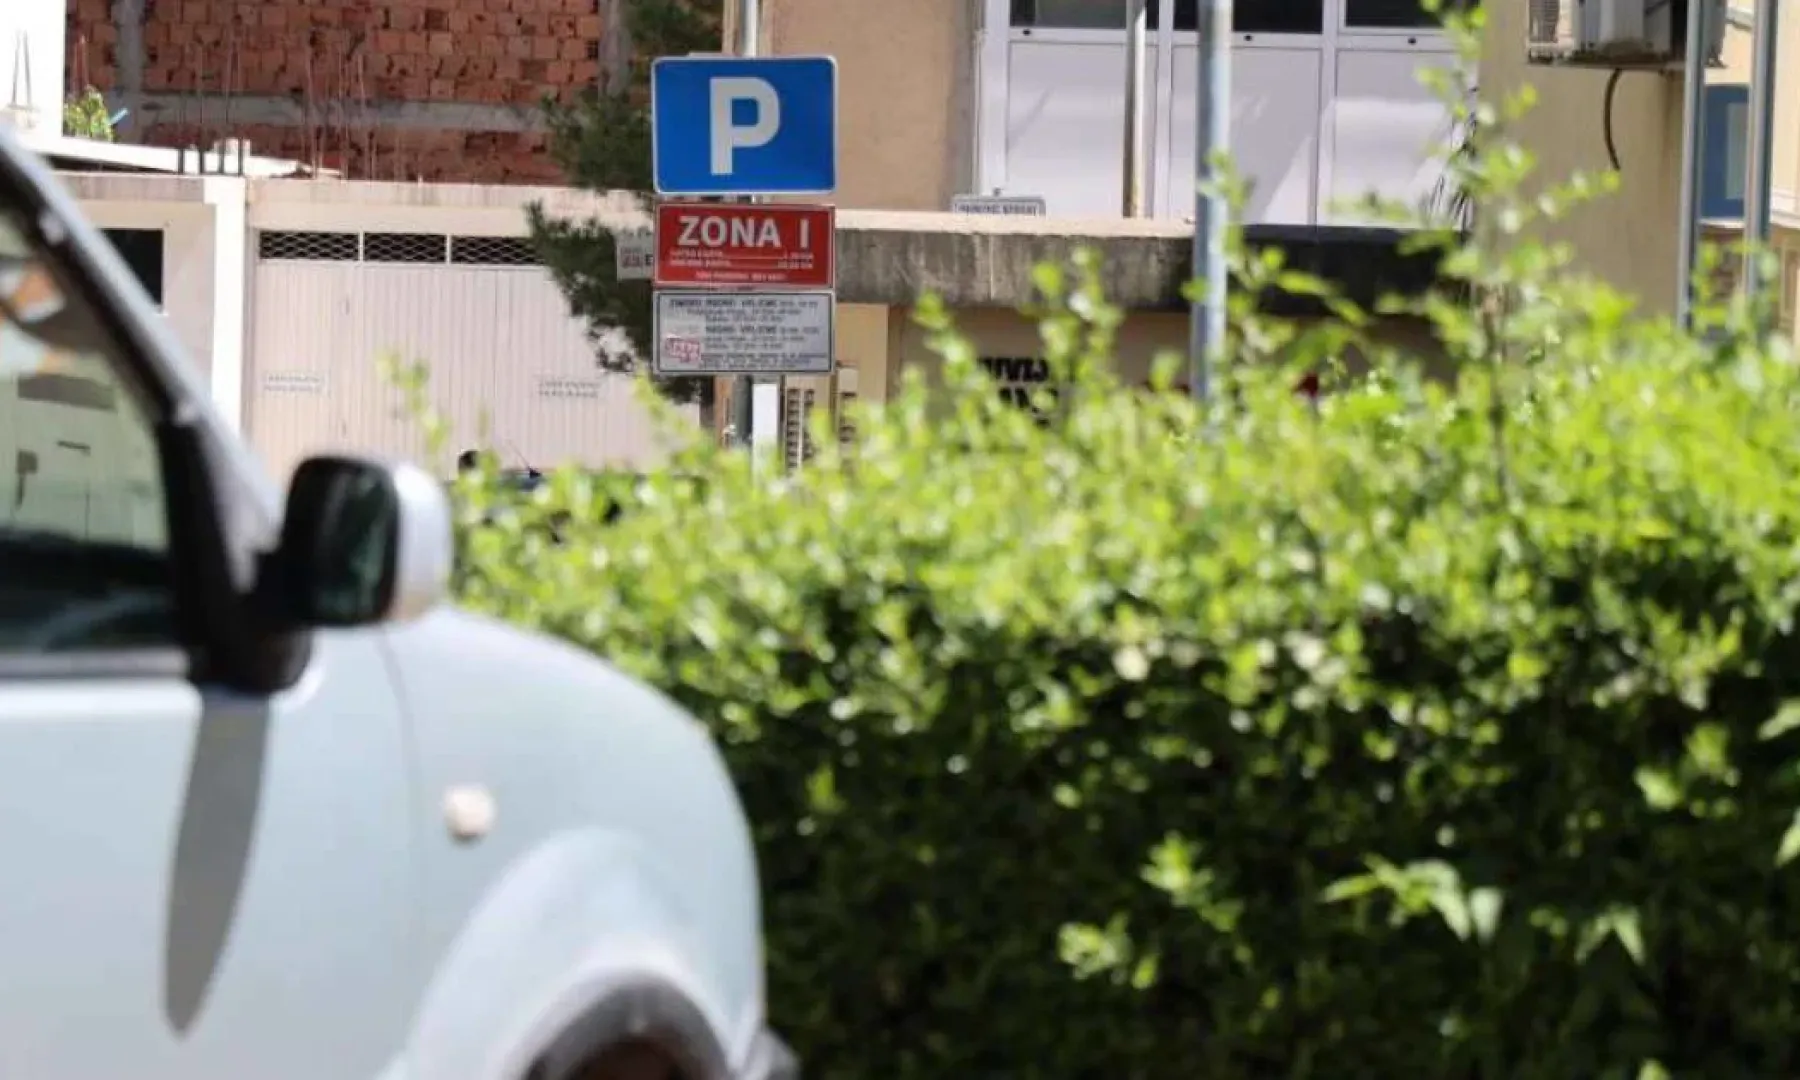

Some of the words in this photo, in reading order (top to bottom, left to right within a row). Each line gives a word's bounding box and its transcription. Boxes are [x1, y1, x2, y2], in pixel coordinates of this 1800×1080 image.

[710, 77, 780, 176] P
[677, 215, 781, 248] ZONA
[799, 218, 811, 249] I
